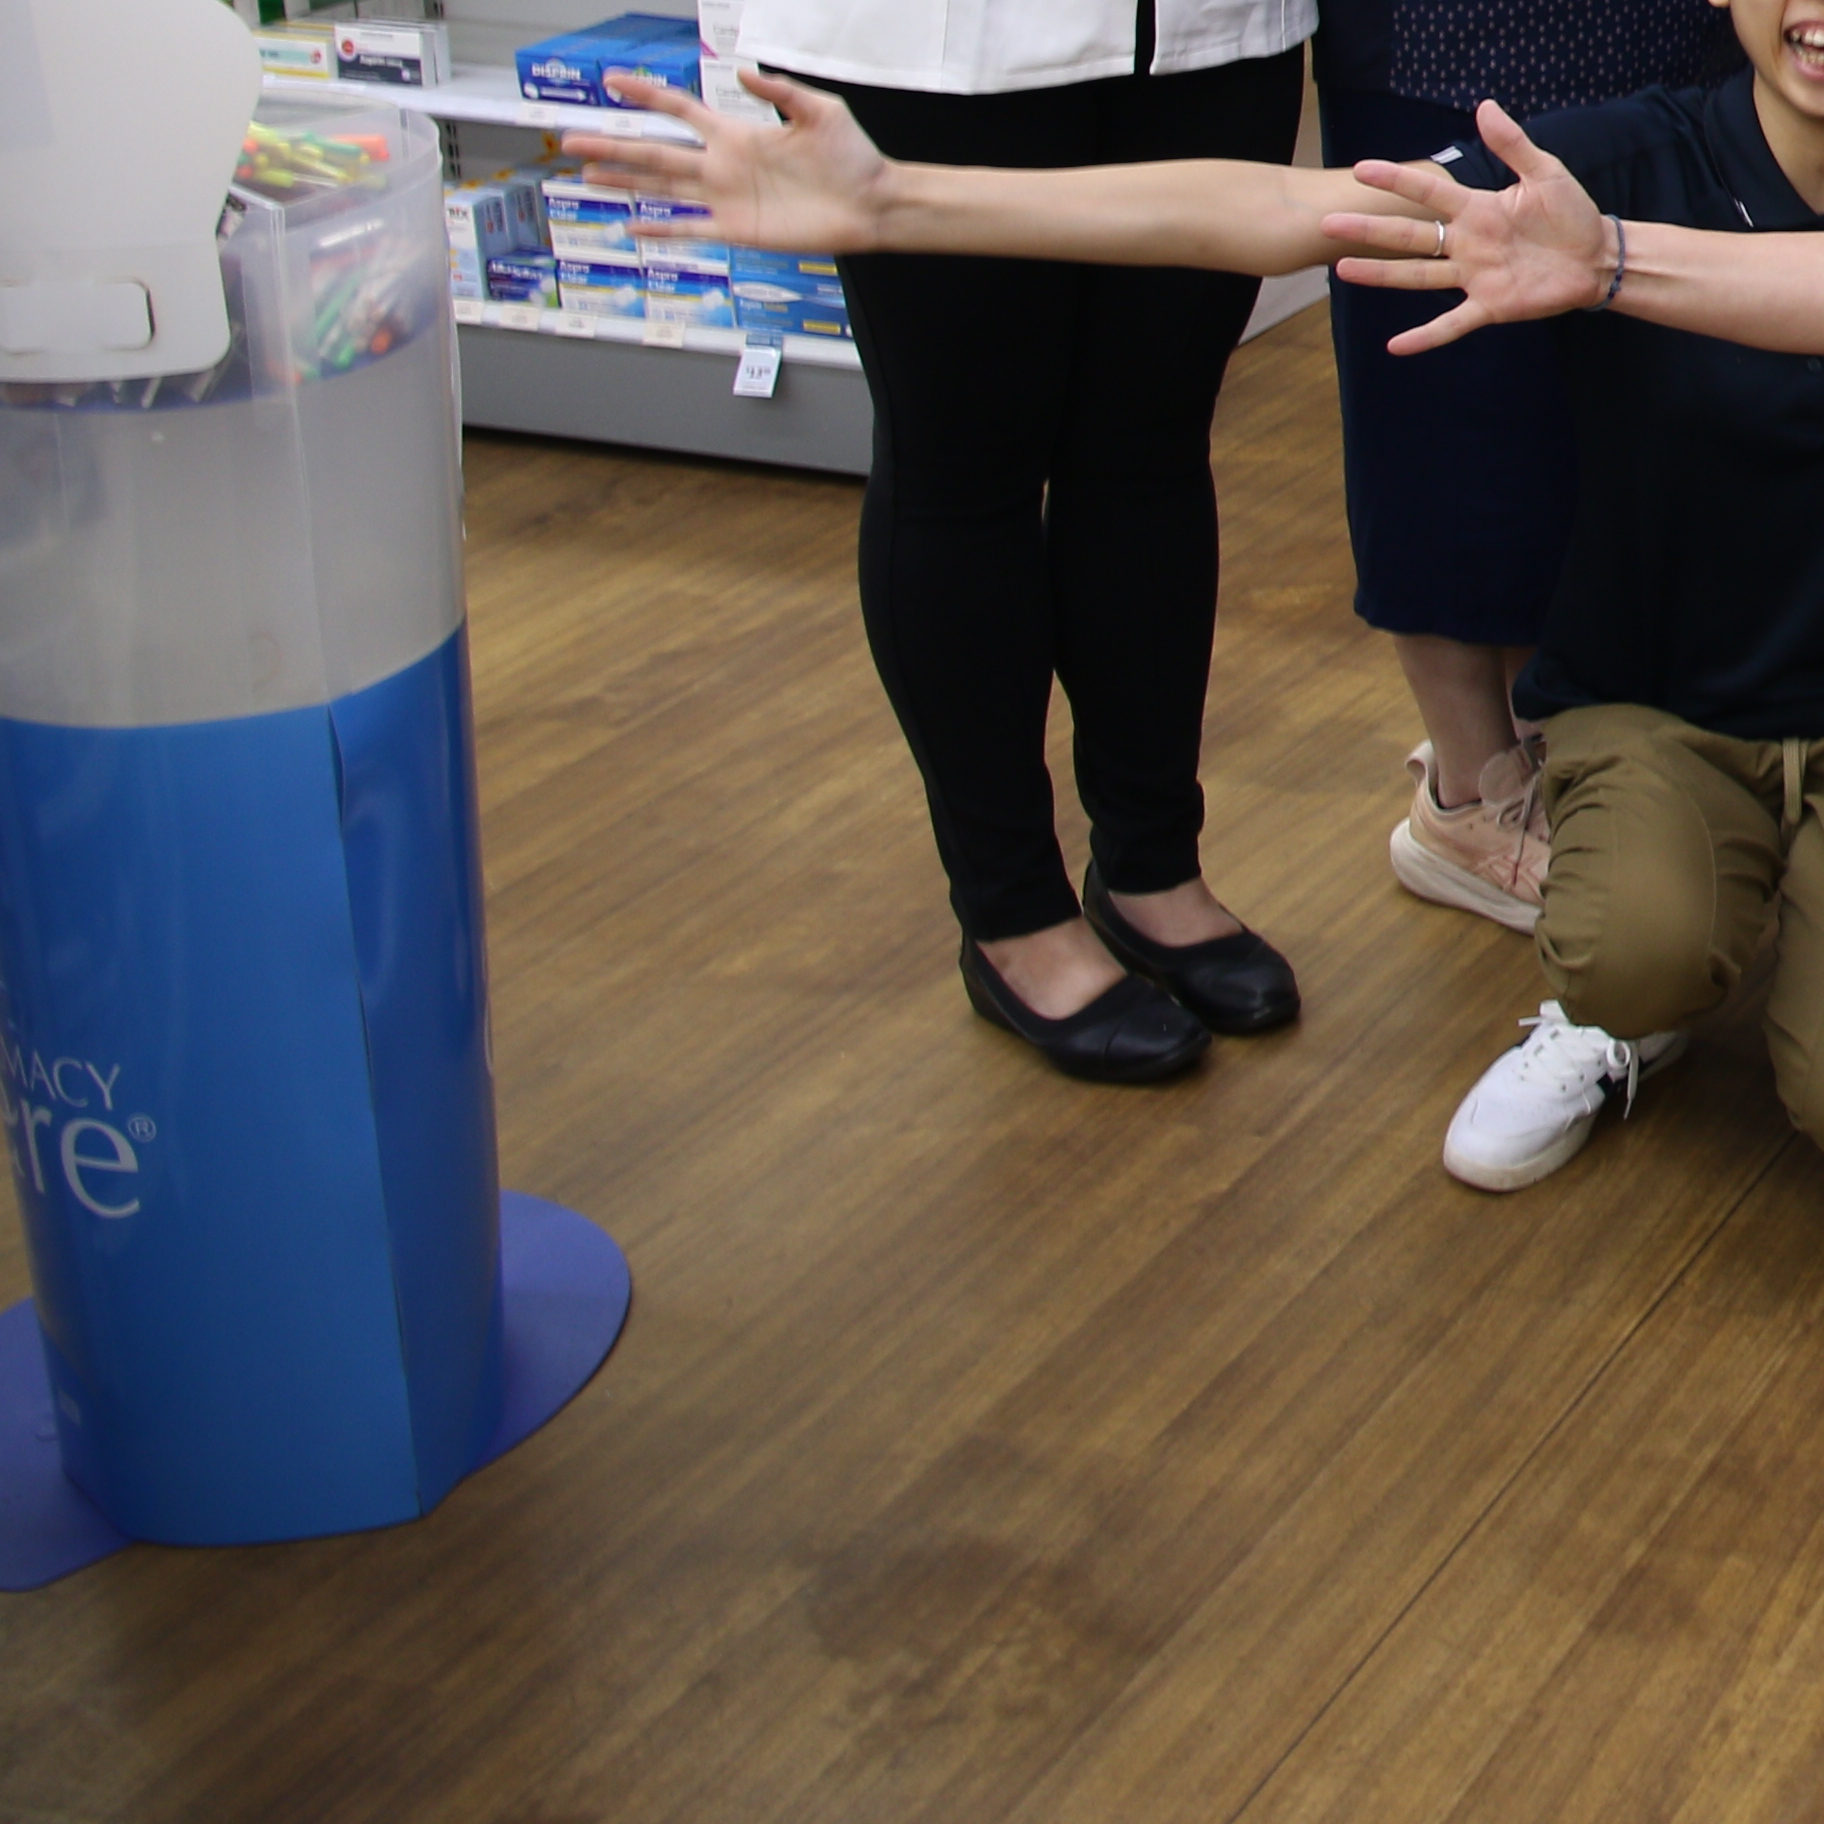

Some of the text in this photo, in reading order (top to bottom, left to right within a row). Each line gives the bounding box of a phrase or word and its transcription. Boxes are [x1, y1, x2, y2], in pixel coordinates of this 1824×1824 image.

[531, 64, 582, 83] DISPRIN
[549, 196, 580, 213] Aspro
[640, 201, 672, 219] Aspro
[559, 259, 591, 276] Aspro
[647, 267, 679, 284] Aspro
